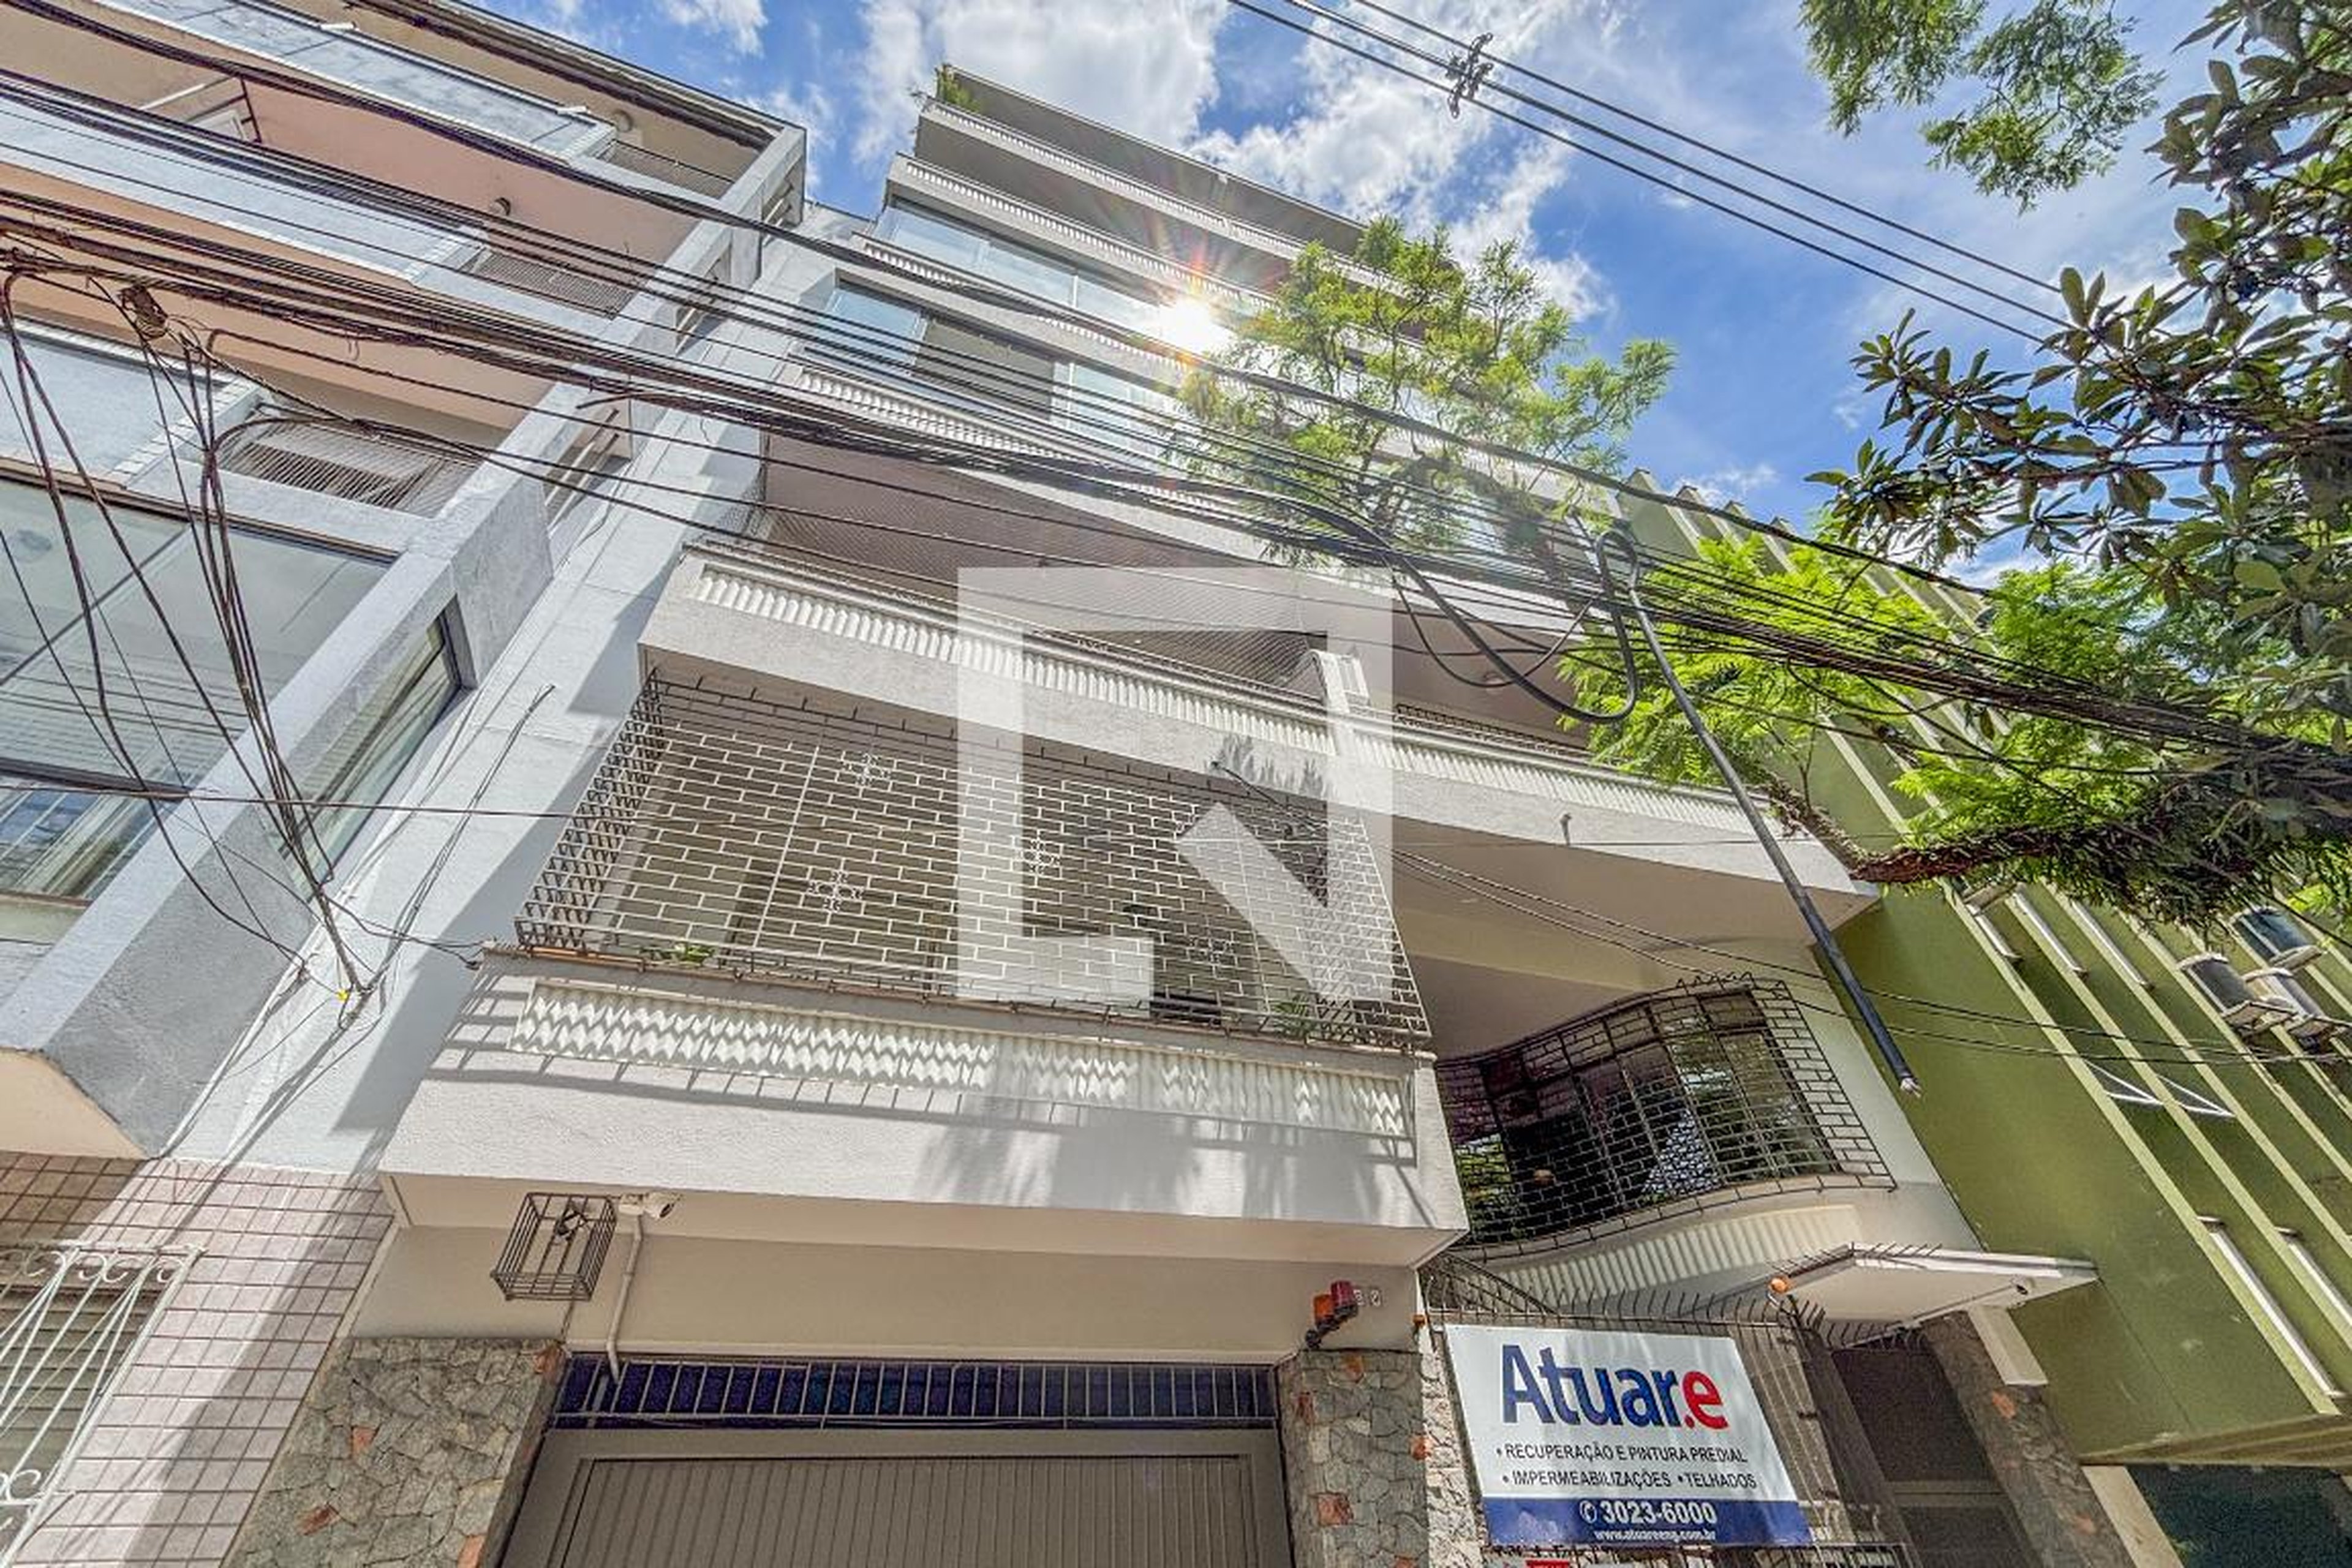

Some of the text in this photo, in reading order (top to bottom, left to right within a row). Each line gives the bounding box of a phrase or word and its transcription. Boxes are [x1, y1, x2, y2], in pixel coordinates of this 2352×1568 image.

[1505, 1441, 1747, 1463] RECUPERAÇÃO E PINTURA PREDIAL
[1512, 1469, 1757, 1490] IMPERMEABILIZAÇÕES TELHADOS
[1600, 1501, 1717, 1524] 3023-6000
